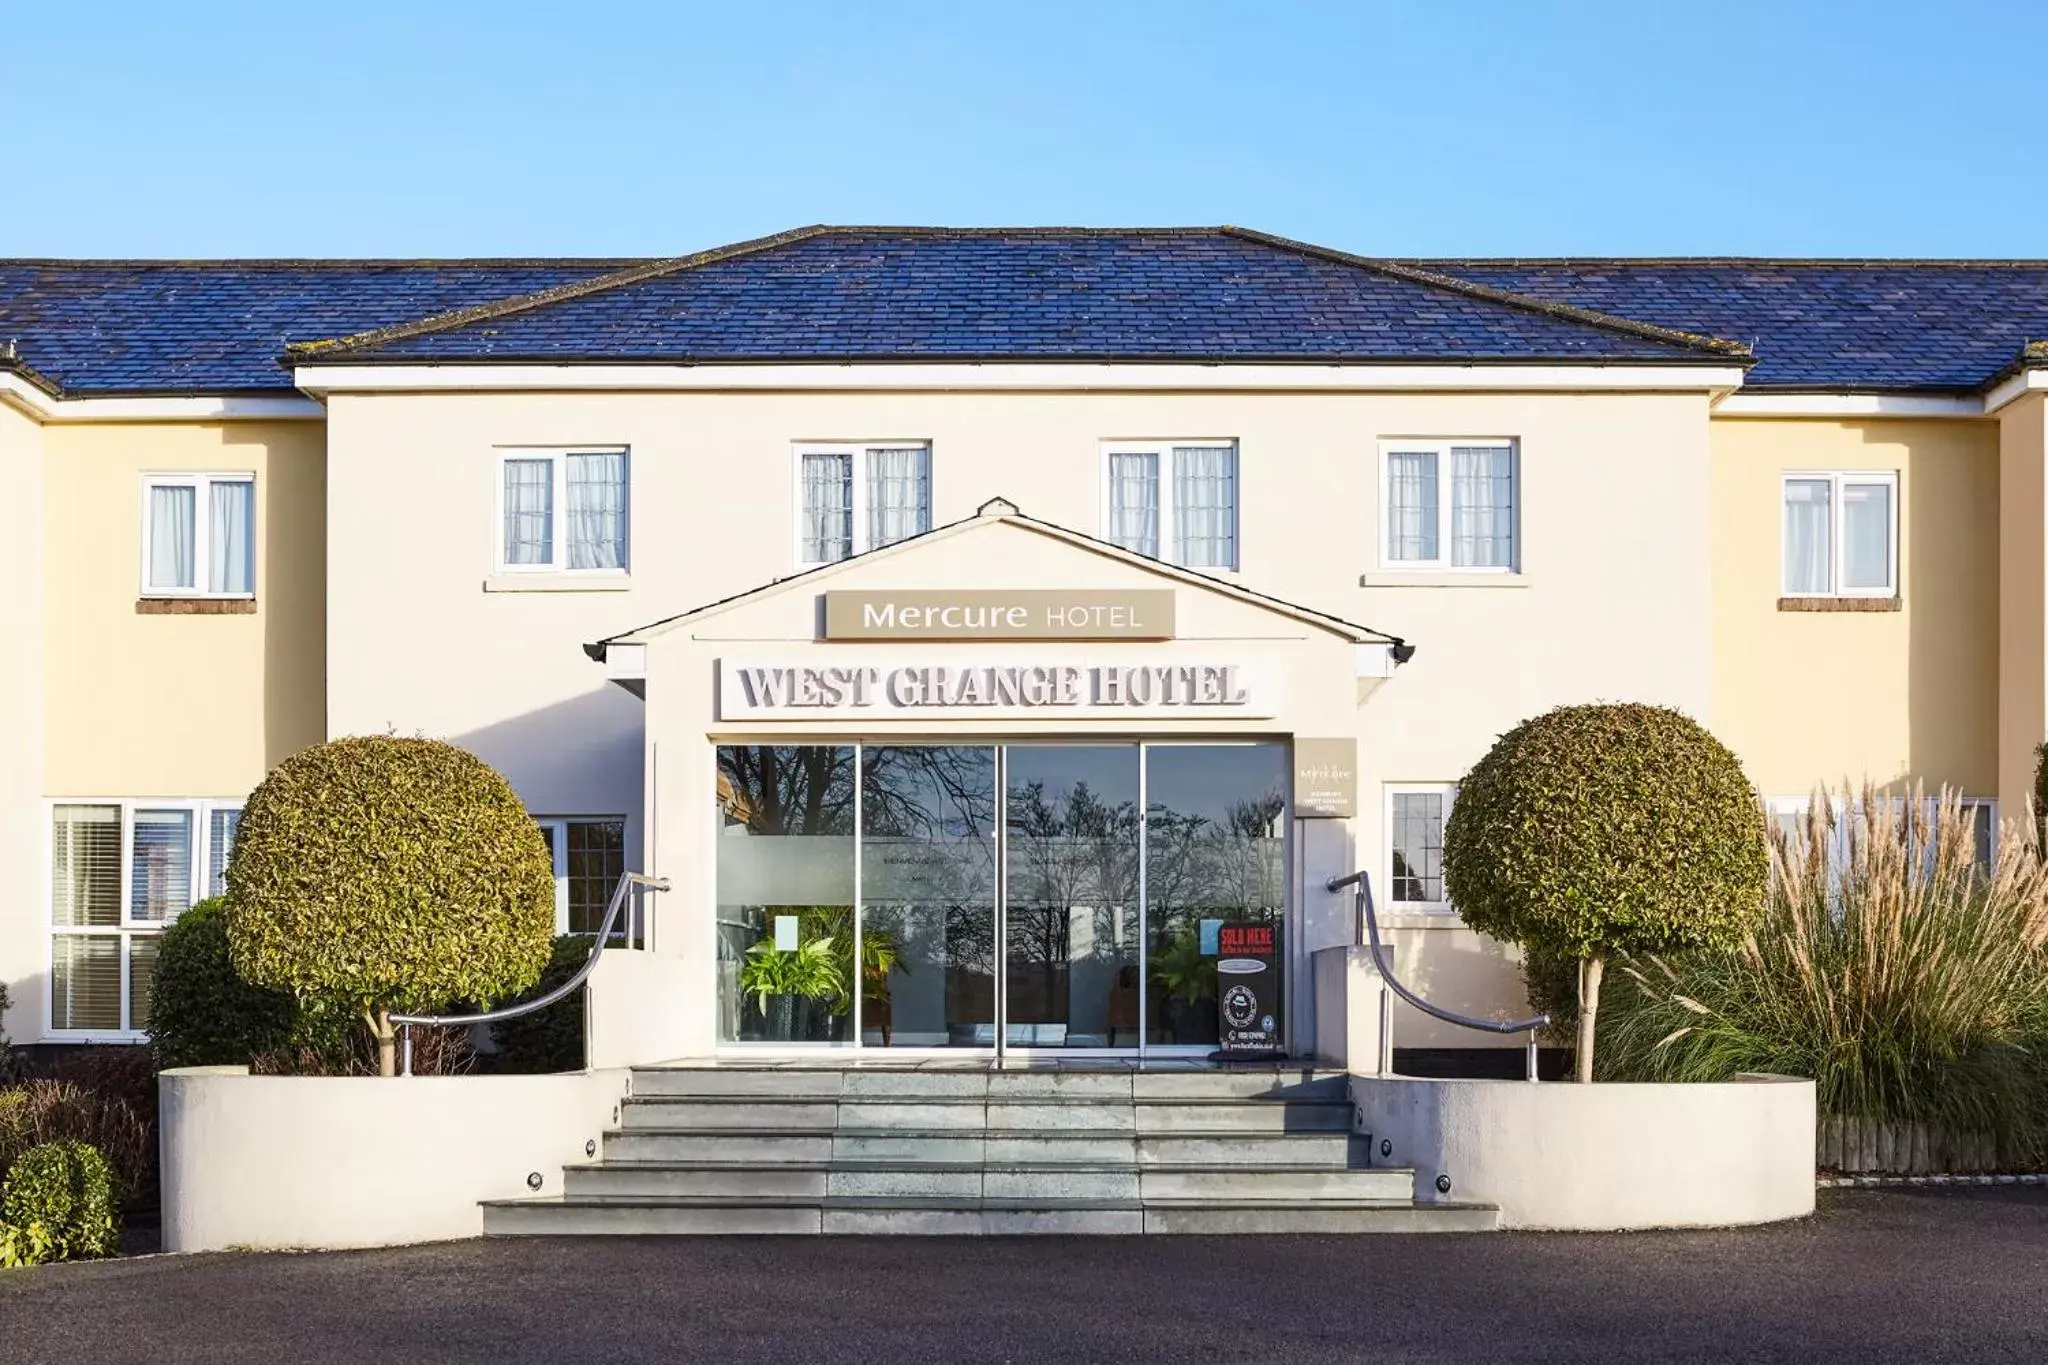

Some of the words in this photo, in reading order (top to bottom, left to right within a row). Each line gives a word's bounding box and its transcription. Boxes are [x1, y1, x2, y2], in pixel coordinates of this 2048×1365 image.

[863, 603, 1028, 628] Mercure
[1046, 606, 1143, 627] HOTEL
[737, 666, 881, 707] WEST
[886, 665, 1082, 707] GRANGE
[1087, 665, 1247, 706] HOTEL
[1221, 928, 1244, 945] SOLD
[1247, 928, 1273, 945] HERE
